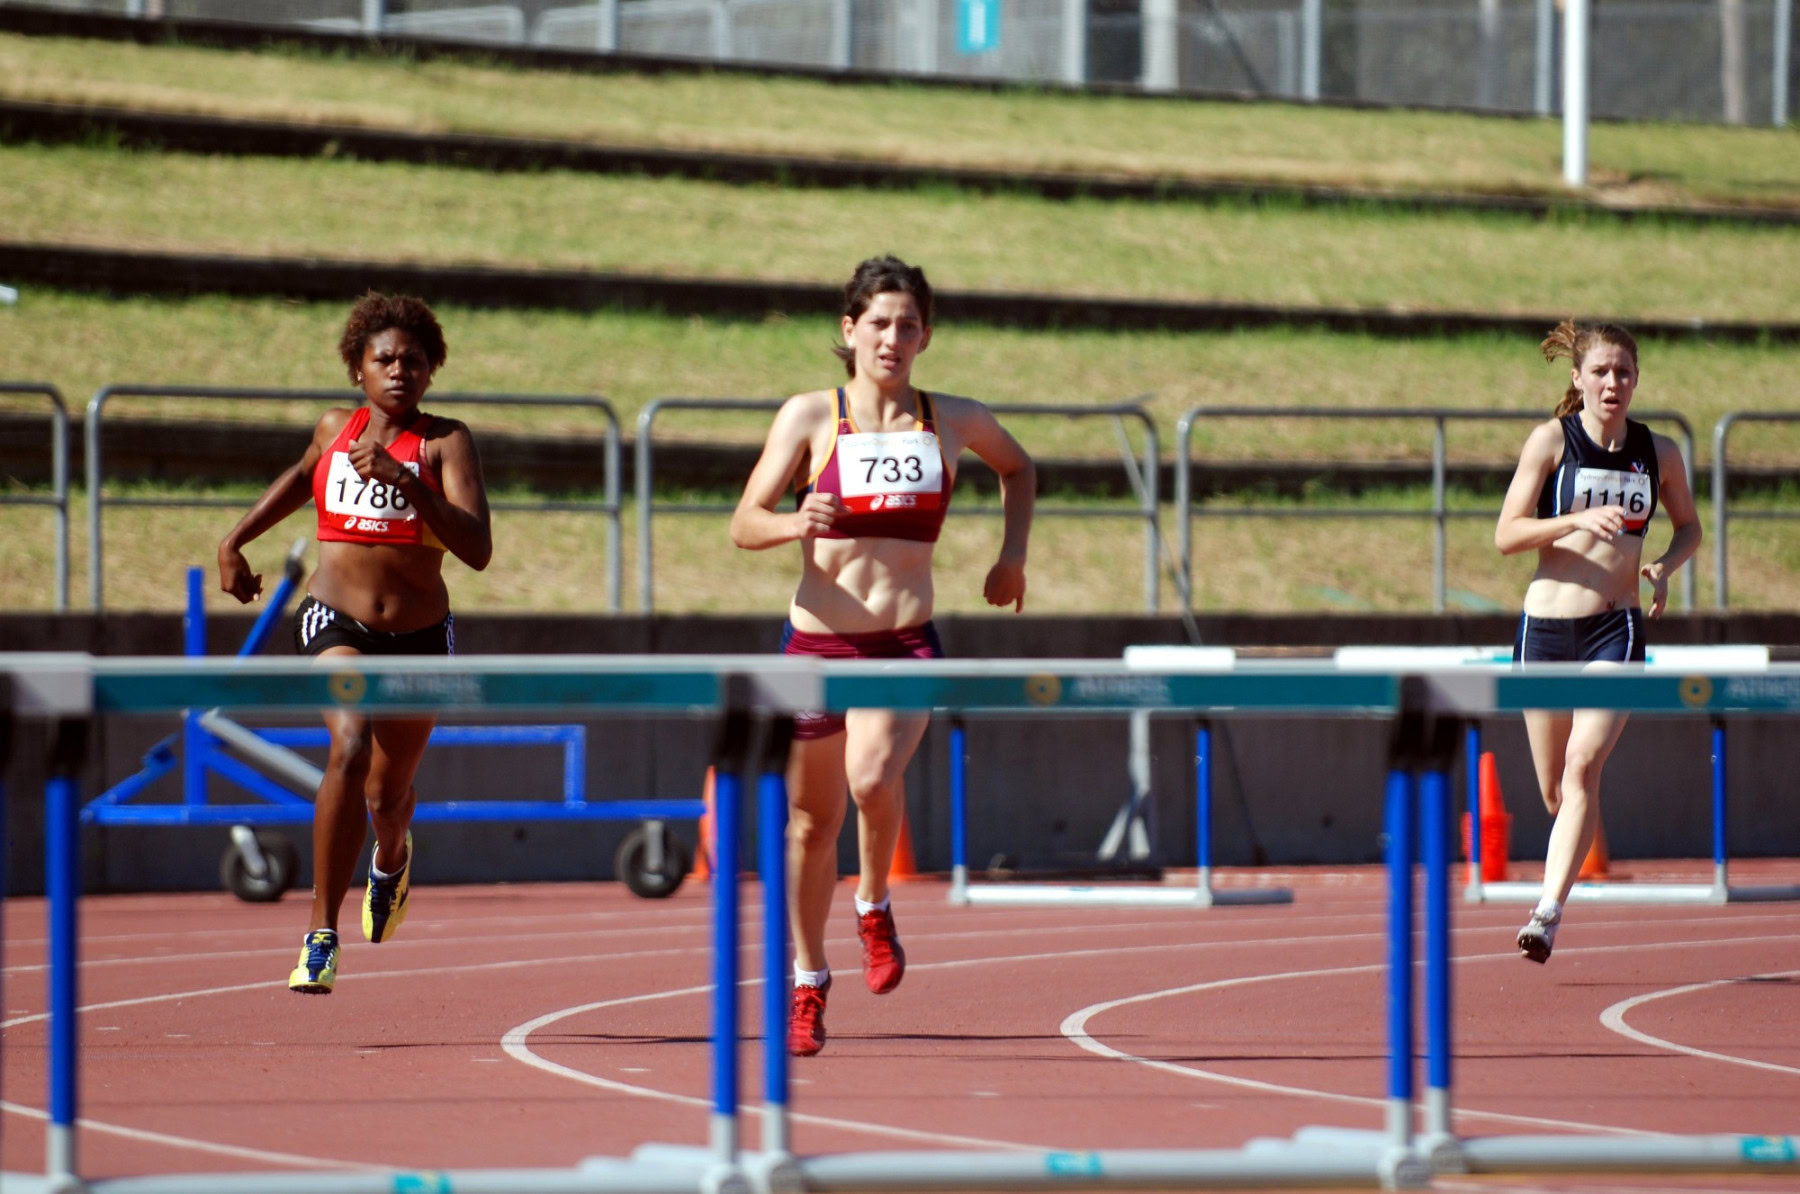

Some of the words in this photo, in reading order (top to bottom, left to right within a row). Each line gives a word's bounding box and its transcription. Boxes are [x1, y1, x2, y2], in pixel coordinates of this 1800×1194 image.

[859, 455, 923, 483] 733
[336, 478, 409, 510] 1786
[1582, 488, 1645, 513] 1116
